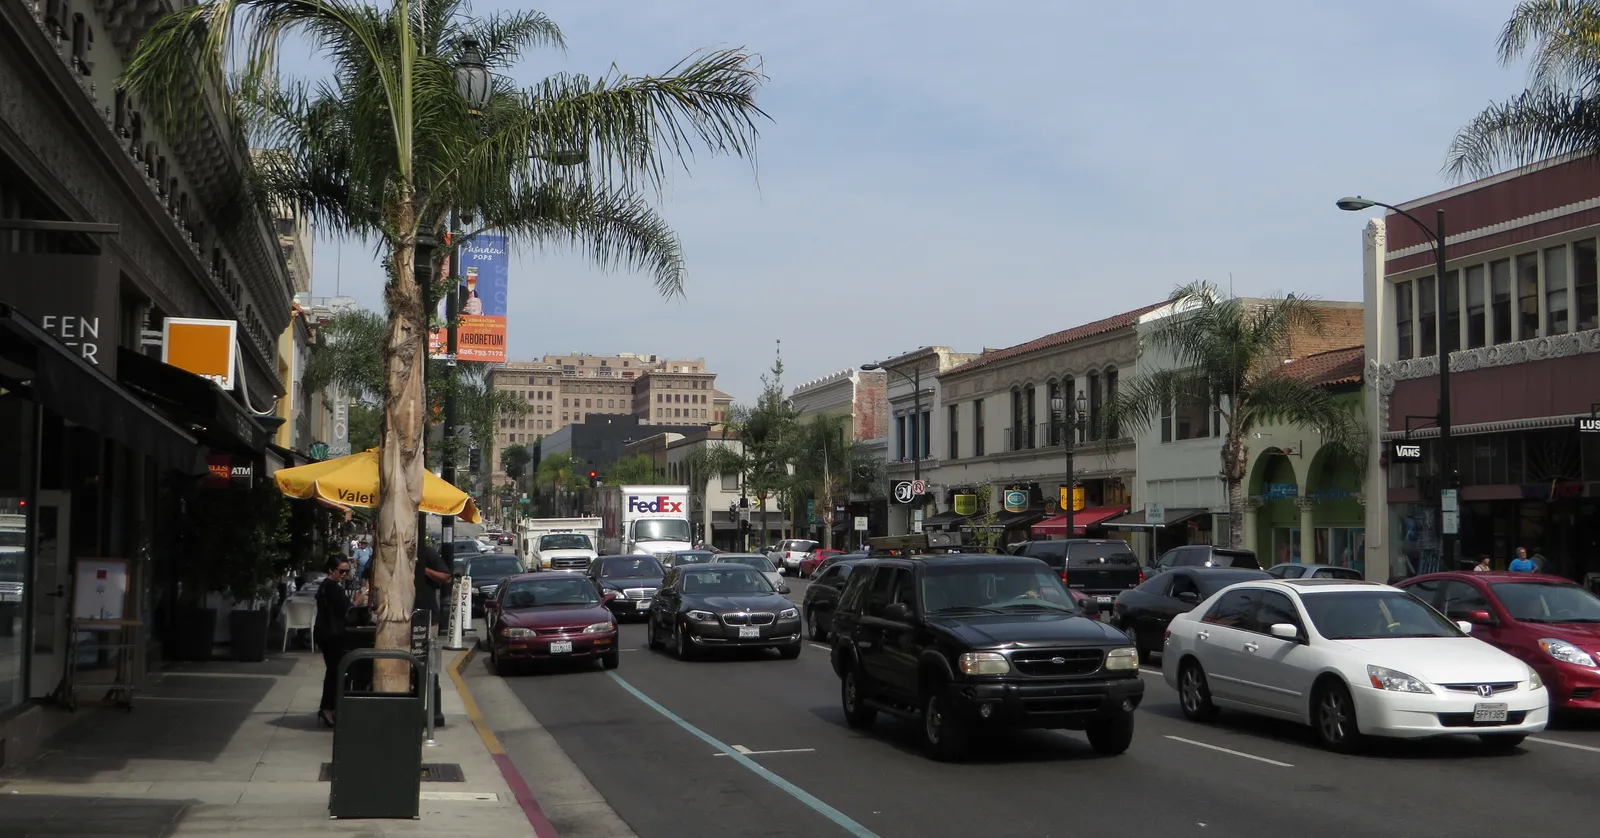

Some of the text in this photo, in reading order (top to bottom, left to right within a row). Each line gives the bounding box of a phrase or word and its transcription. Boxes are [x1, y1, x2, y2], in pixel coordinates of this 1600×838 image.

[460, 333, 503, 346] ARBORETUM
[1395, 445, 1421, 458] VANS
[231, 466, 251, 475] ATM
[338, 488, 375, 504] Valet
[628, 496, 683, 513] FedEx
[448, 606, 458, 642] VALET
